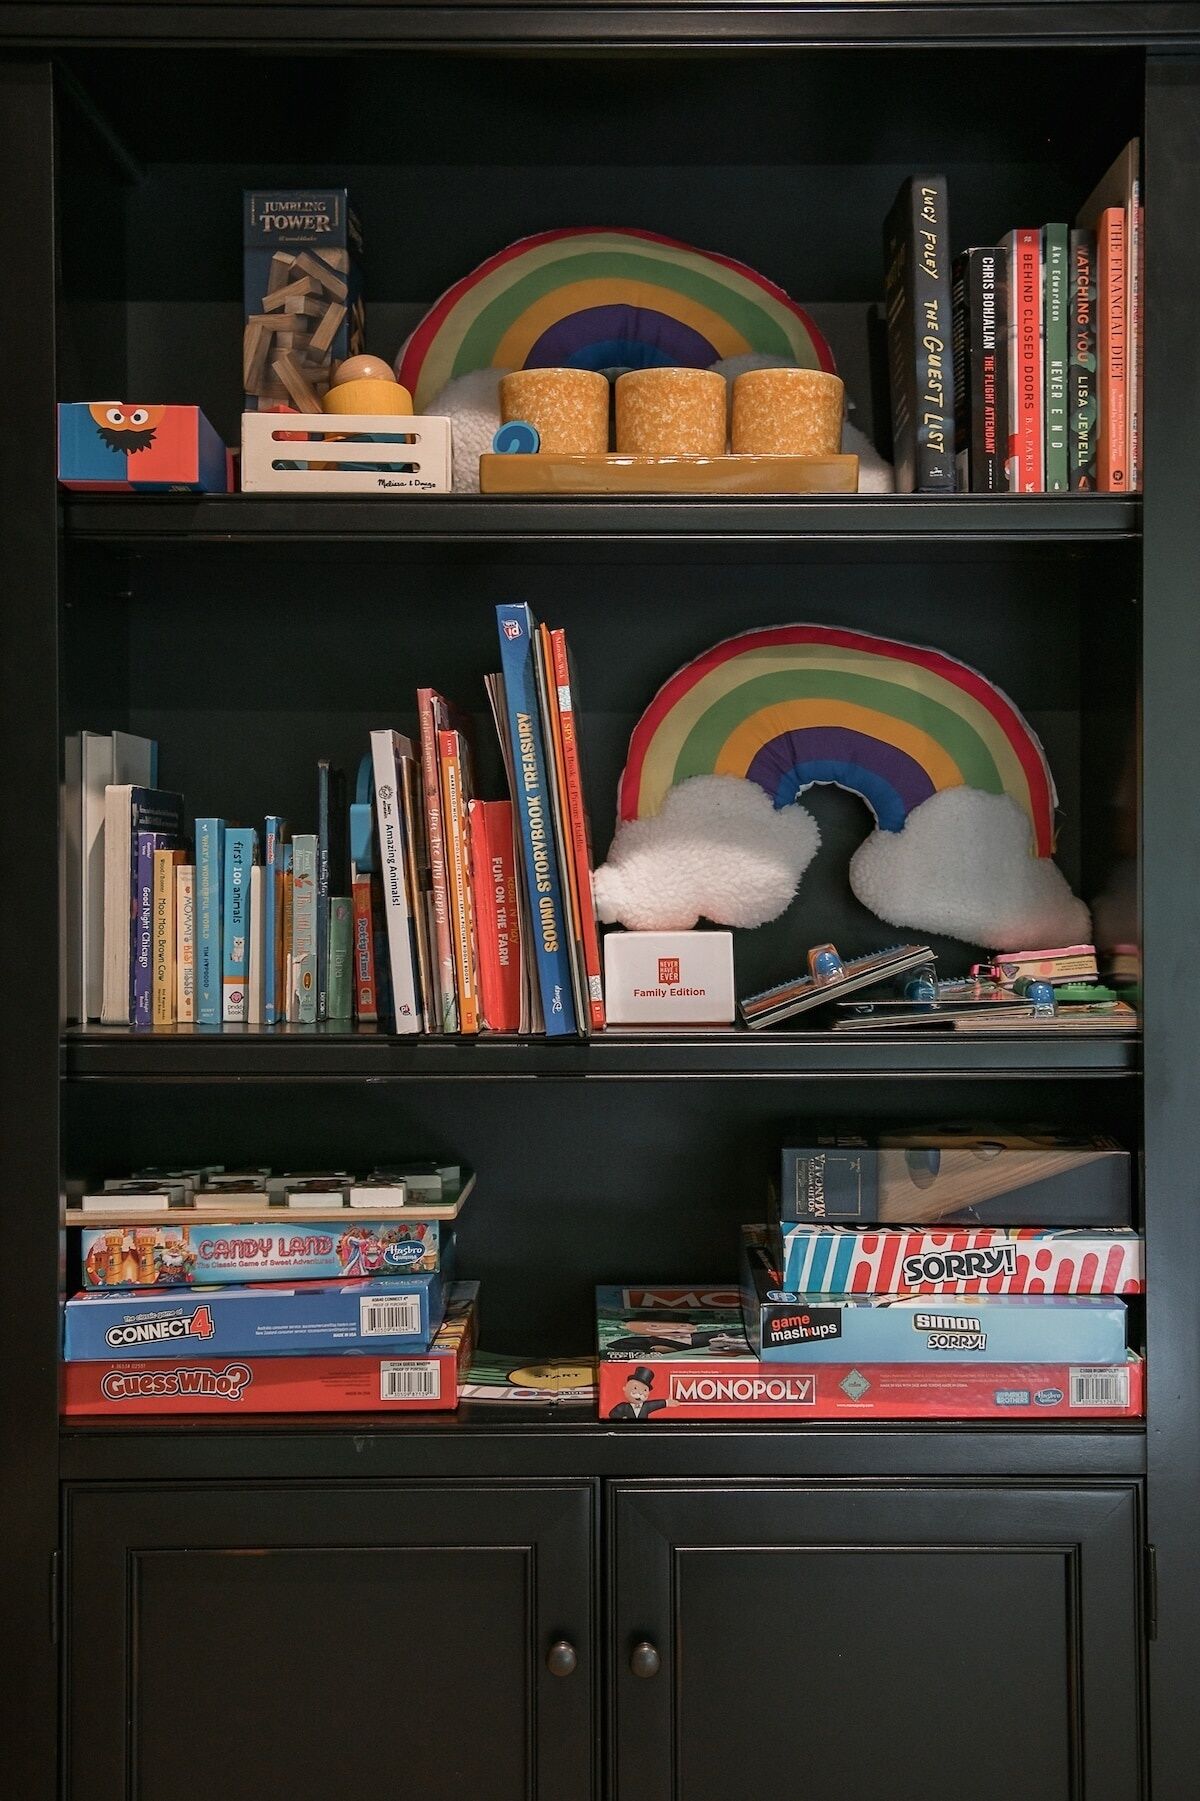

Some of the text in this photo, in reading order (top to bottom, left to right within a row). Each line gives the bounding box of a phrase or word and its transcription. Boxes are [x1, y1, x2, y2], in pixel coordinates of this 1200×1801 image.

[260, 215, 331, 232] TOWER
[263, 202, 326, 214] JUMBLING
[982, 257, 994, 290] CHRIS
[1024, 254, 1032, 302] BEHIND
[1052, 270, 1061, 321] Edwardson
[1111, 220, 1123, 382] THE FINANCIAL DIET
[924, 300, 939, 330] THE
[982, 293, 996, 349] BOHJALIAN
[1024, 309, 1033, 359] CLOSED
[984, 356, 995, 372] THE
[1077, 245, 1089, 466] WATCHING YOU LISA JEWELL
[922, 336, 944, 408] GUEST
[1024, 366, 1034, 409] DOORS
[1052, 361, 1062, 398] NEVER
[984, 374, 996, 405] FLIGHT
[924, 412, 944, 454] LIST
[985, 406, 996, 454] ATTENDANT
[1026, 439, 1034, 472] PARIS
[378, 478, 407, 488] Melissa
[563, 722, 572, 744] SPY:
[567, 756, 575, 776] Book
[571, 791, 579, 820] Picture
[516, 712, 559, 953] SOUND STORYBOOK TREASURY
[386, 824, 400, 906] Amazing Animals!
[429, 808, 445, 924] You Are My Happy
[233, 842, 244, 924] first 100 animals
[492, 856, 509, 966] FUN ON THE FARM
[139, 887, 150, 968] Good Night Chicago
[158, 919, 166, 938] Moo,
[358, 920, 368, 950] Potty
[509, 920, 519, 944] Play
[184, 945, 192, 965] BEST
[360, 952, 371, 981] Time!
[634, 988, 705, 997] Family Edition
[814, 1153, 826, 1217] MANCALA
[199, 1236, 333, 1260] CANDY LAND
[386, 1245, 422, 1255] Hasbro
[905, 1248, 1016, 1282] SORRY!
[108, 1308, 212, 1344] CONNECT 4
[135, 1312, 157, 1320] classic
[158, 1310, 174, 1319] game
[771, 1314, 810, 1331] game
[928, 1334, 986, 1349] SORRY!
[106, 1367, 250, 1397] Guess Who?
[675, 1379, 812, 1400] MONOPOLY
